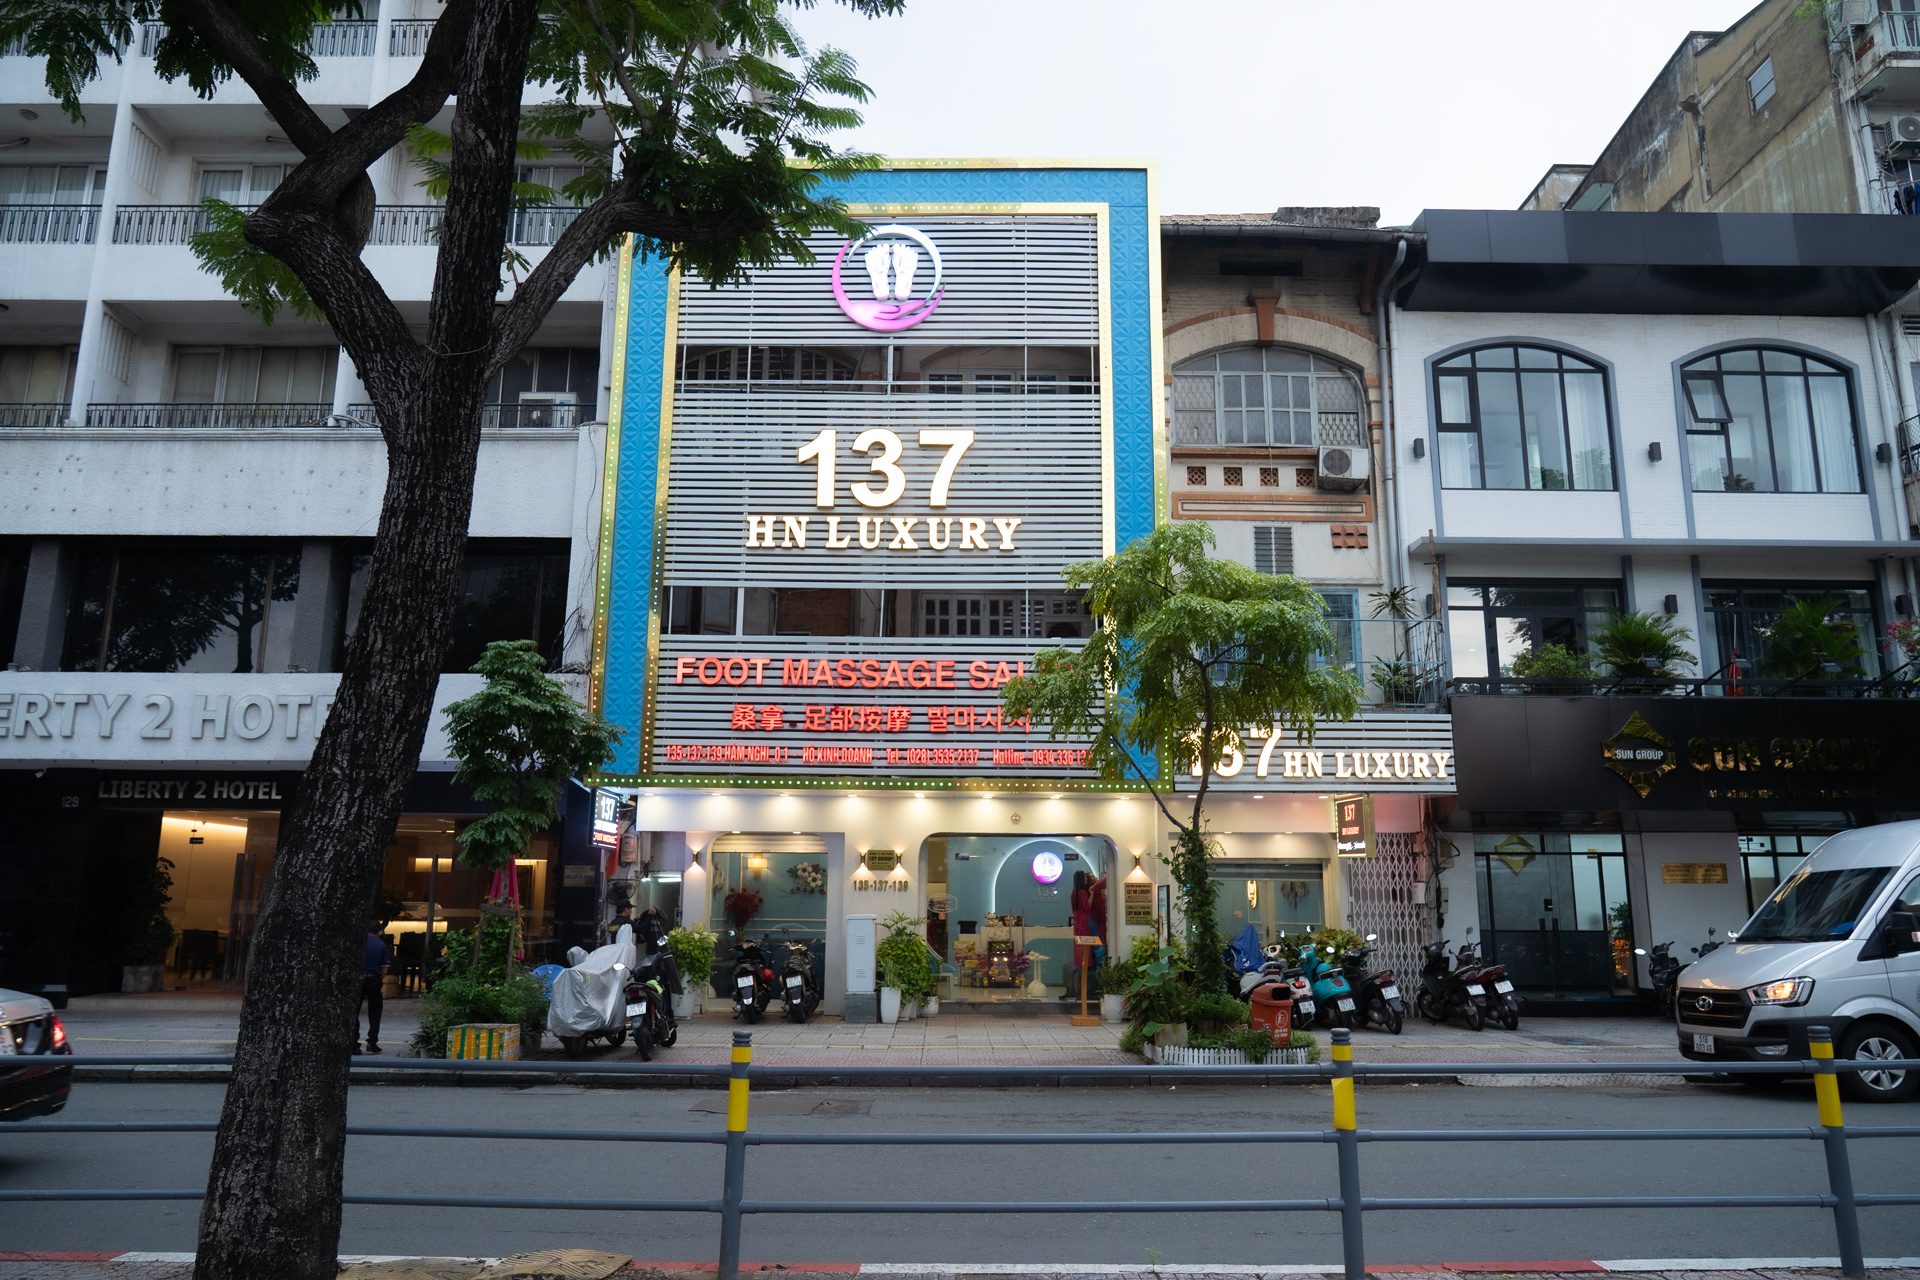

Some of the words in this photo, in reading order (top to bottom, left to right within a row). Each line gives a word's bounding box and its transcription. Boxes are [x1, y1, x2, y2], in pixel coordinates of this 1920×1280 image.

[797, 428, 974, 508] 137
[746, 515, 811, 549] HN
[825, 516, 1022, 551] LUXURY
[676, 657, 771, 686] FOOT
[782, 658, 957, 689] MASSAGE
[140, 694, 174, 739] 2
[803, 704, 912, 732] 足部按摩
[665, 744, 723, 762] 135-137-139
[774, 746, 789, 764] Q.1
[817, 746, 840, 764] KINH
[841, 747, 873, 764] DOANH
[906, 747, 930, 766] (028)
[932, 748, 955, 765] 3535
[957, 748, 979, 765] 2137
[1032, 749, 1055, 766] 0934
[1057, 749, 1073, 766] 336
[1075, 749, 1092, 766] 13
[1283, 751, 1323, 778] HN
[1335, 751, 1451, 779] LUXURY
[1616, 749, 1634, 759] SUN
[1635, 750, 1664, 760] GROUP
[1688, 737, 1761, 772] SUN
[61, 796, 80, 808] 129
[97, 780, 190, 799] LIBERTY
[194, 780, 208, 799] 2
[213, 781, 283, 800] HOTEL
[600, 796, 616, 821] 137
[1344, 803, 1356, 821] 137
[853, 880, 909, 892] 135-137-139
[1699, 1035, 1708, 1043] 51B
